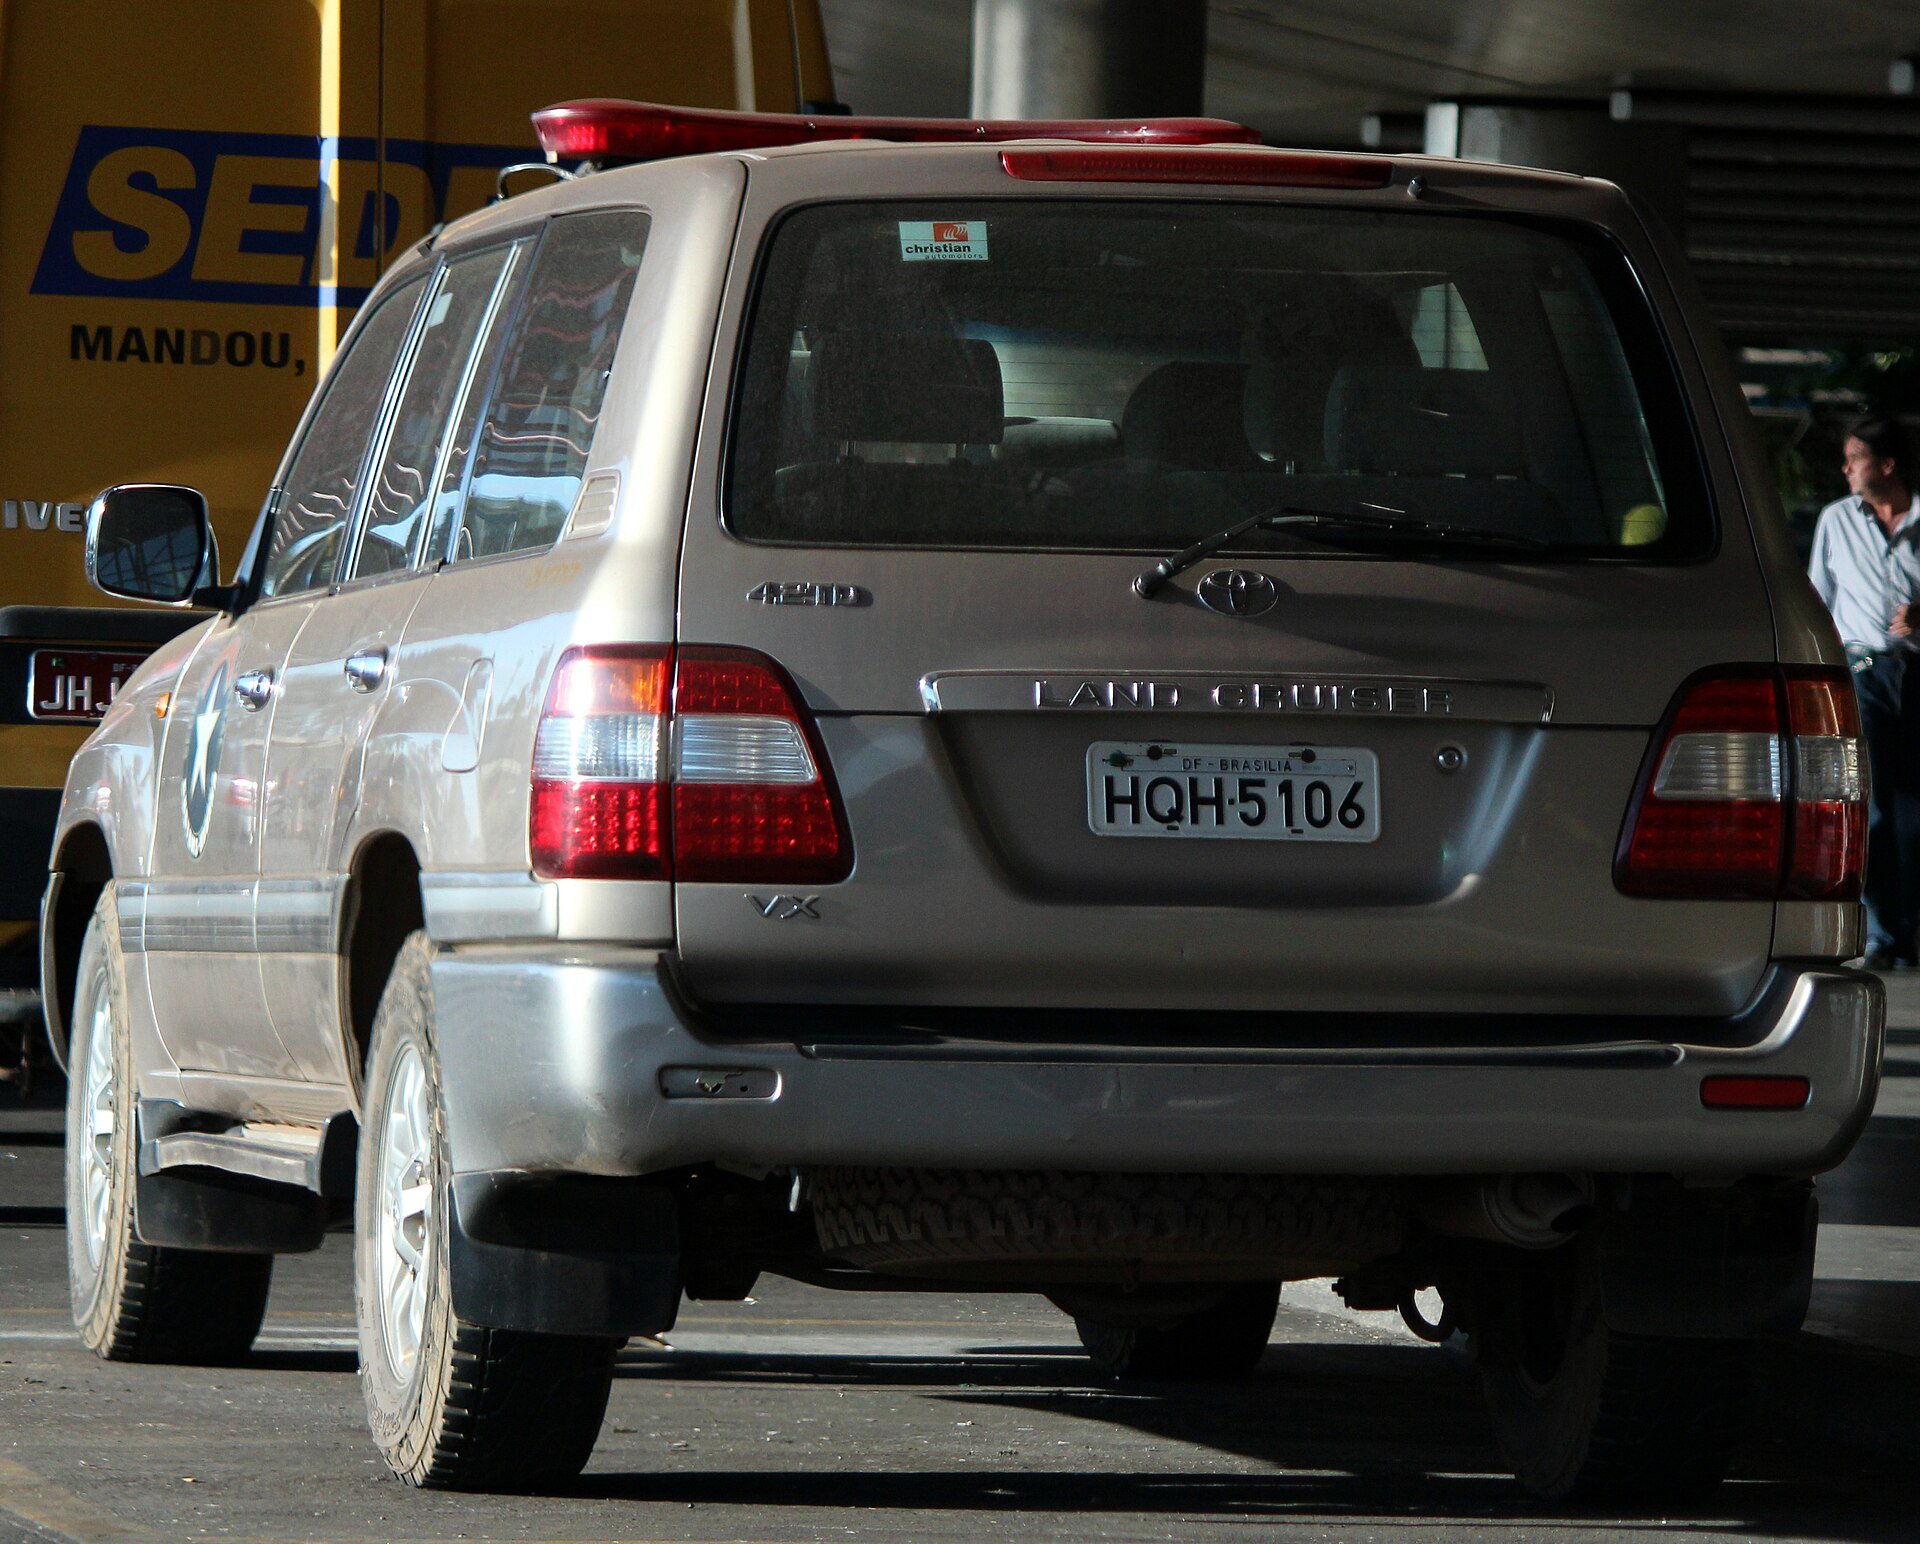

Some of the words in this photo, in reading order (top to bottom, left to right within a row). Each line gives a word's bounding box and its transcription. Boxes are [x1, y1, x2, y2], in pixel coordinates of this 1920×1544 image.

[905, 243, 971, 254] christian
[70, 324, 306, 376] MANDOU,
[1034, 680, 1183, 710] LAND
[1213, 683, 1453, 713] CRUISER
[742, 893, 821, 919] VX
